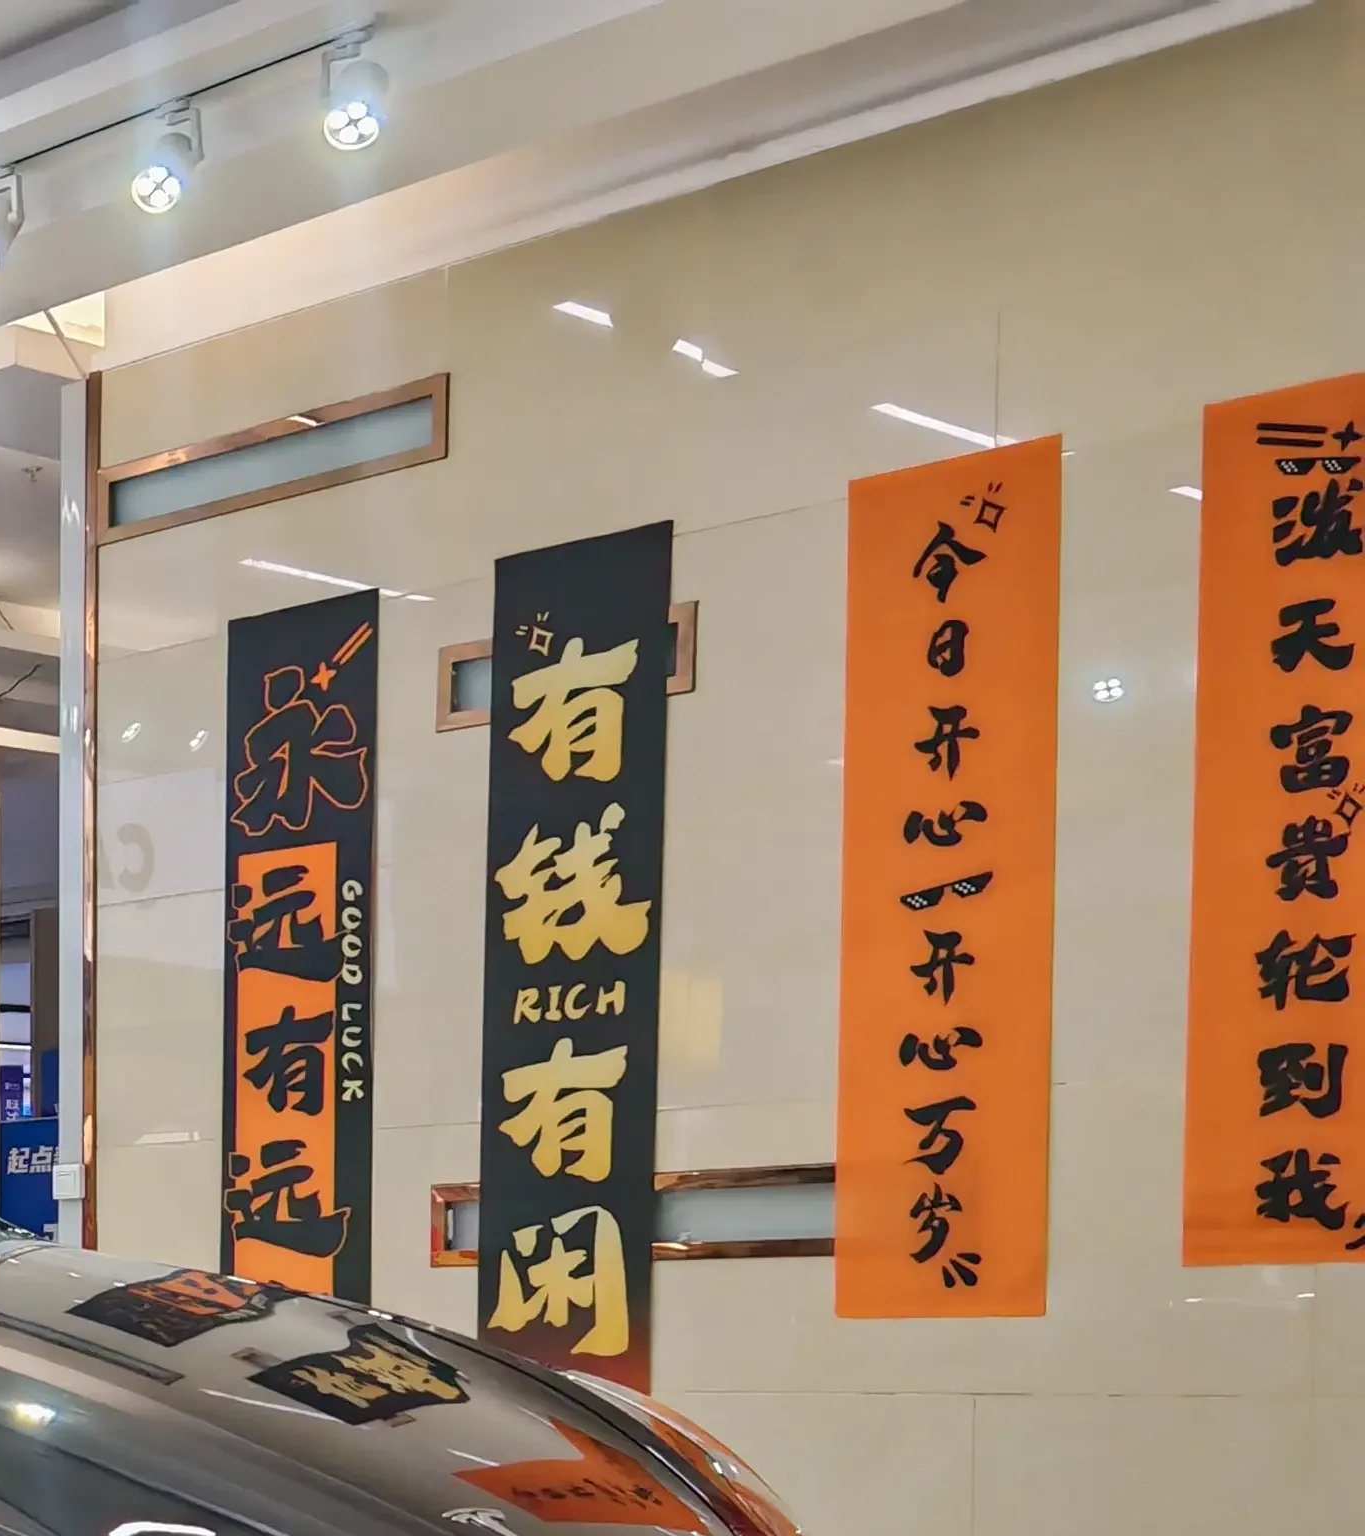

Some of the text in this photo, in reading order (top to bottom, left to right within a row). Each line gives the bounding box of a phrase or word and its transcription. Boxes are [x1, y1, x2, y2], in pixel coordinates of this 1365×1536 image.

[224, 667, 367, 1290] 永远有远
[340, 878, 365, 1103] GOOD LUCK
[513, 979, 627, 1026] RICH
[7, 1146, 59, 1174] 起点
